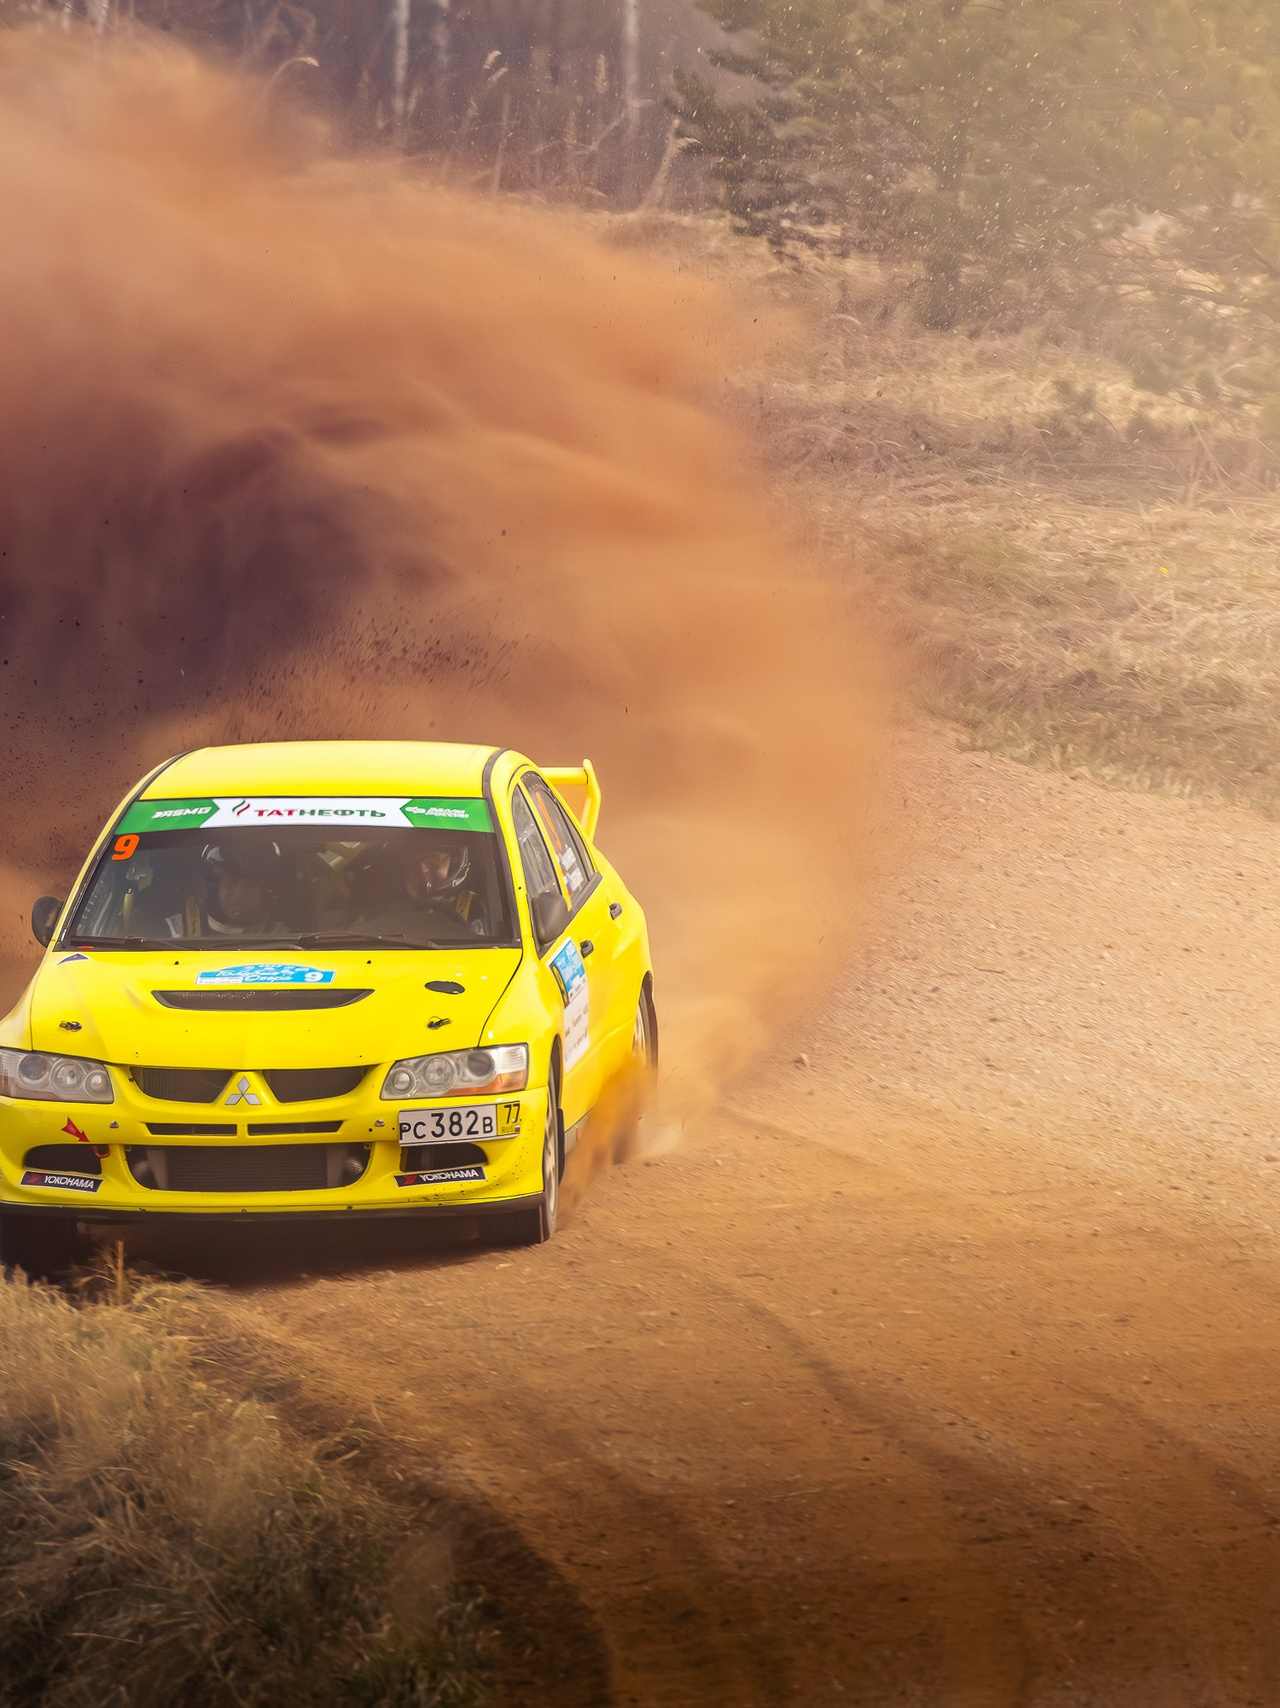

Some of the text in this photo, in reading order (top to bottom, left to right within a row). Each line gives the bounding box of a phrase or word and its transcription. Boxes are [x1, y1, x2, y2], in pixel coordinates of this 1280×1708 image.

[254, 809, 386, 817] ТАТНЕФТЬ
[111, 834, 140, 861] 9
[304, 971, 324, 983] 9
[503, 1103, 520, 1125] 77
[420, 1169, 479, 1181] YOKOHAMA
[43, 1175, 95, 1189] YOKOHAMA
